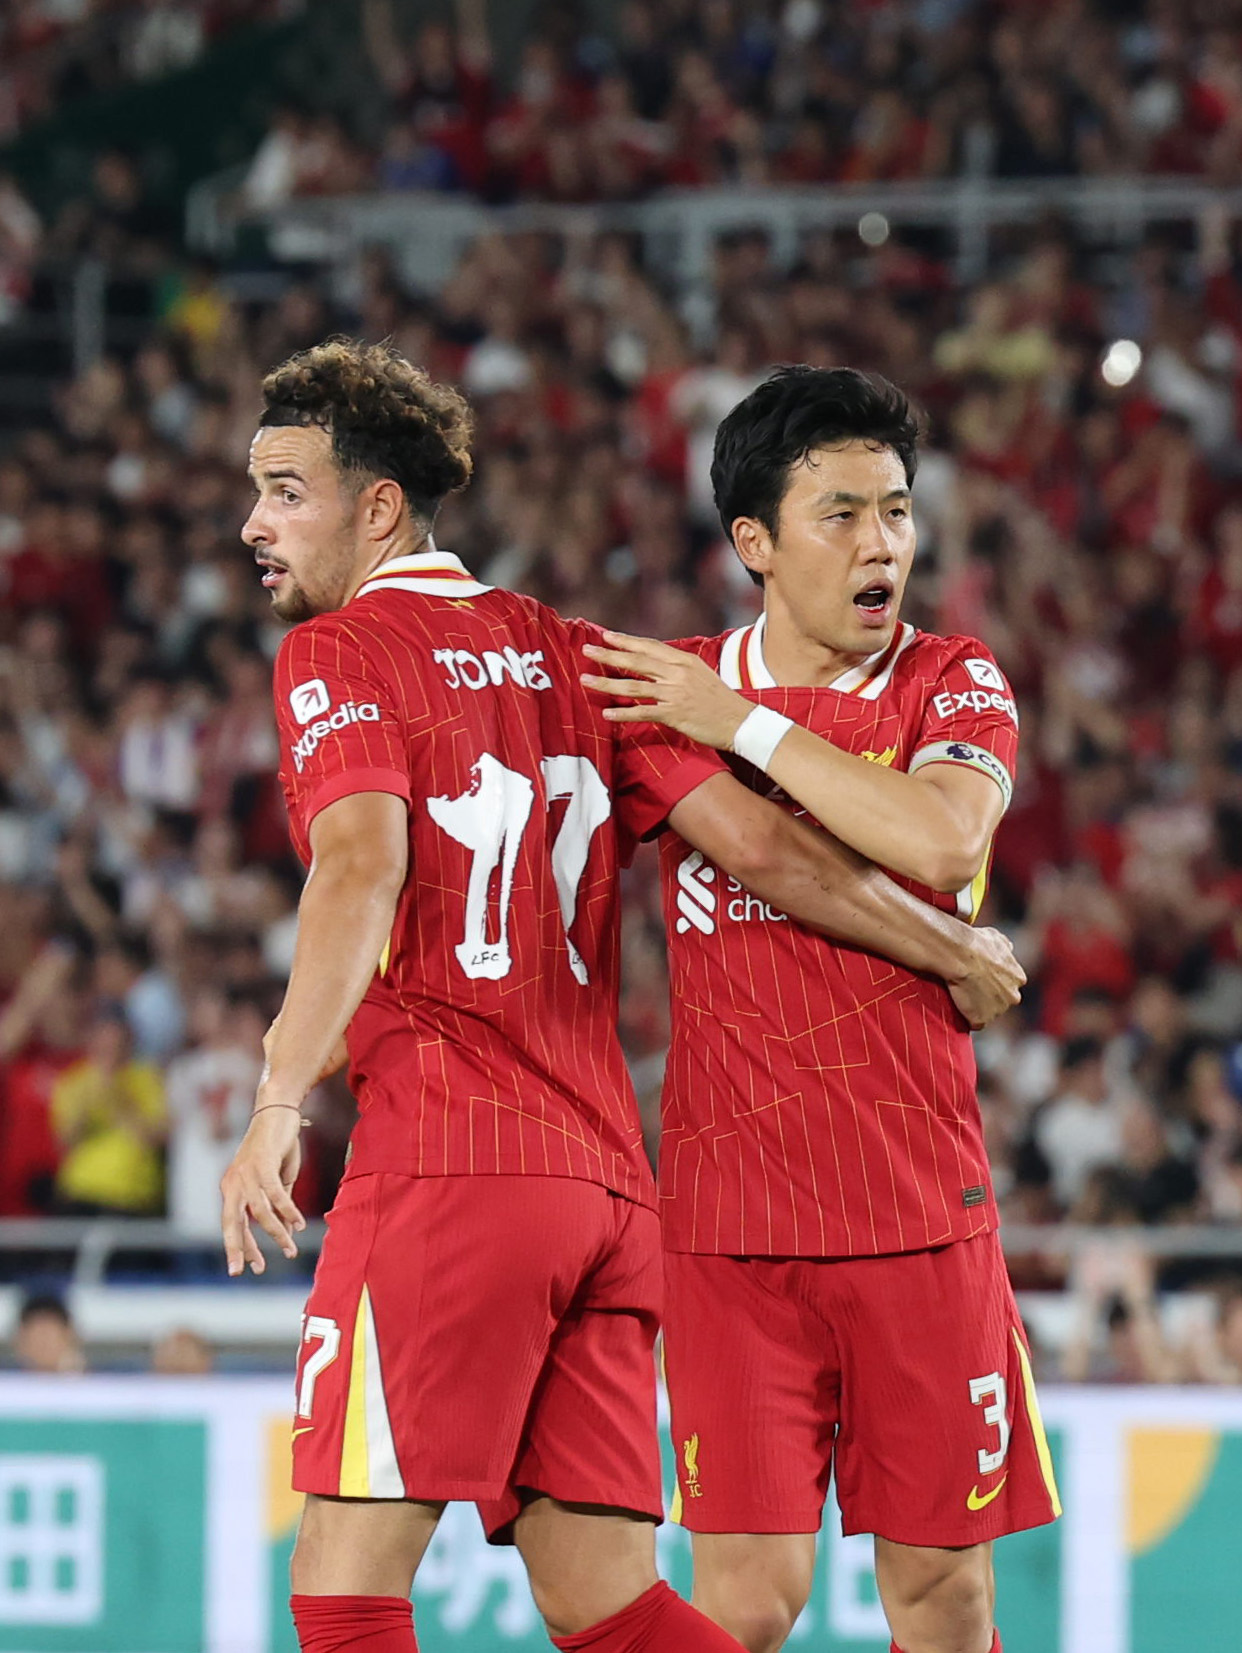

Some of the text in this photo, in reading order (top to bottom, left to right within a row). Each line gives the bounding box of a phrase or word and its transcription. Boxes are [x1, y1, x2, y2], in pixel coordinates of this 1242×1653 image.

[432, 645, 553, 691] JONES
[933, 690, 1019, 731] Exped
[426, 752, 612, 986] 17
[471, 951, 499, 966] LFC
[295, 1313, 341, 1420] 7
[968, 1371, 1010, 1476] 3
